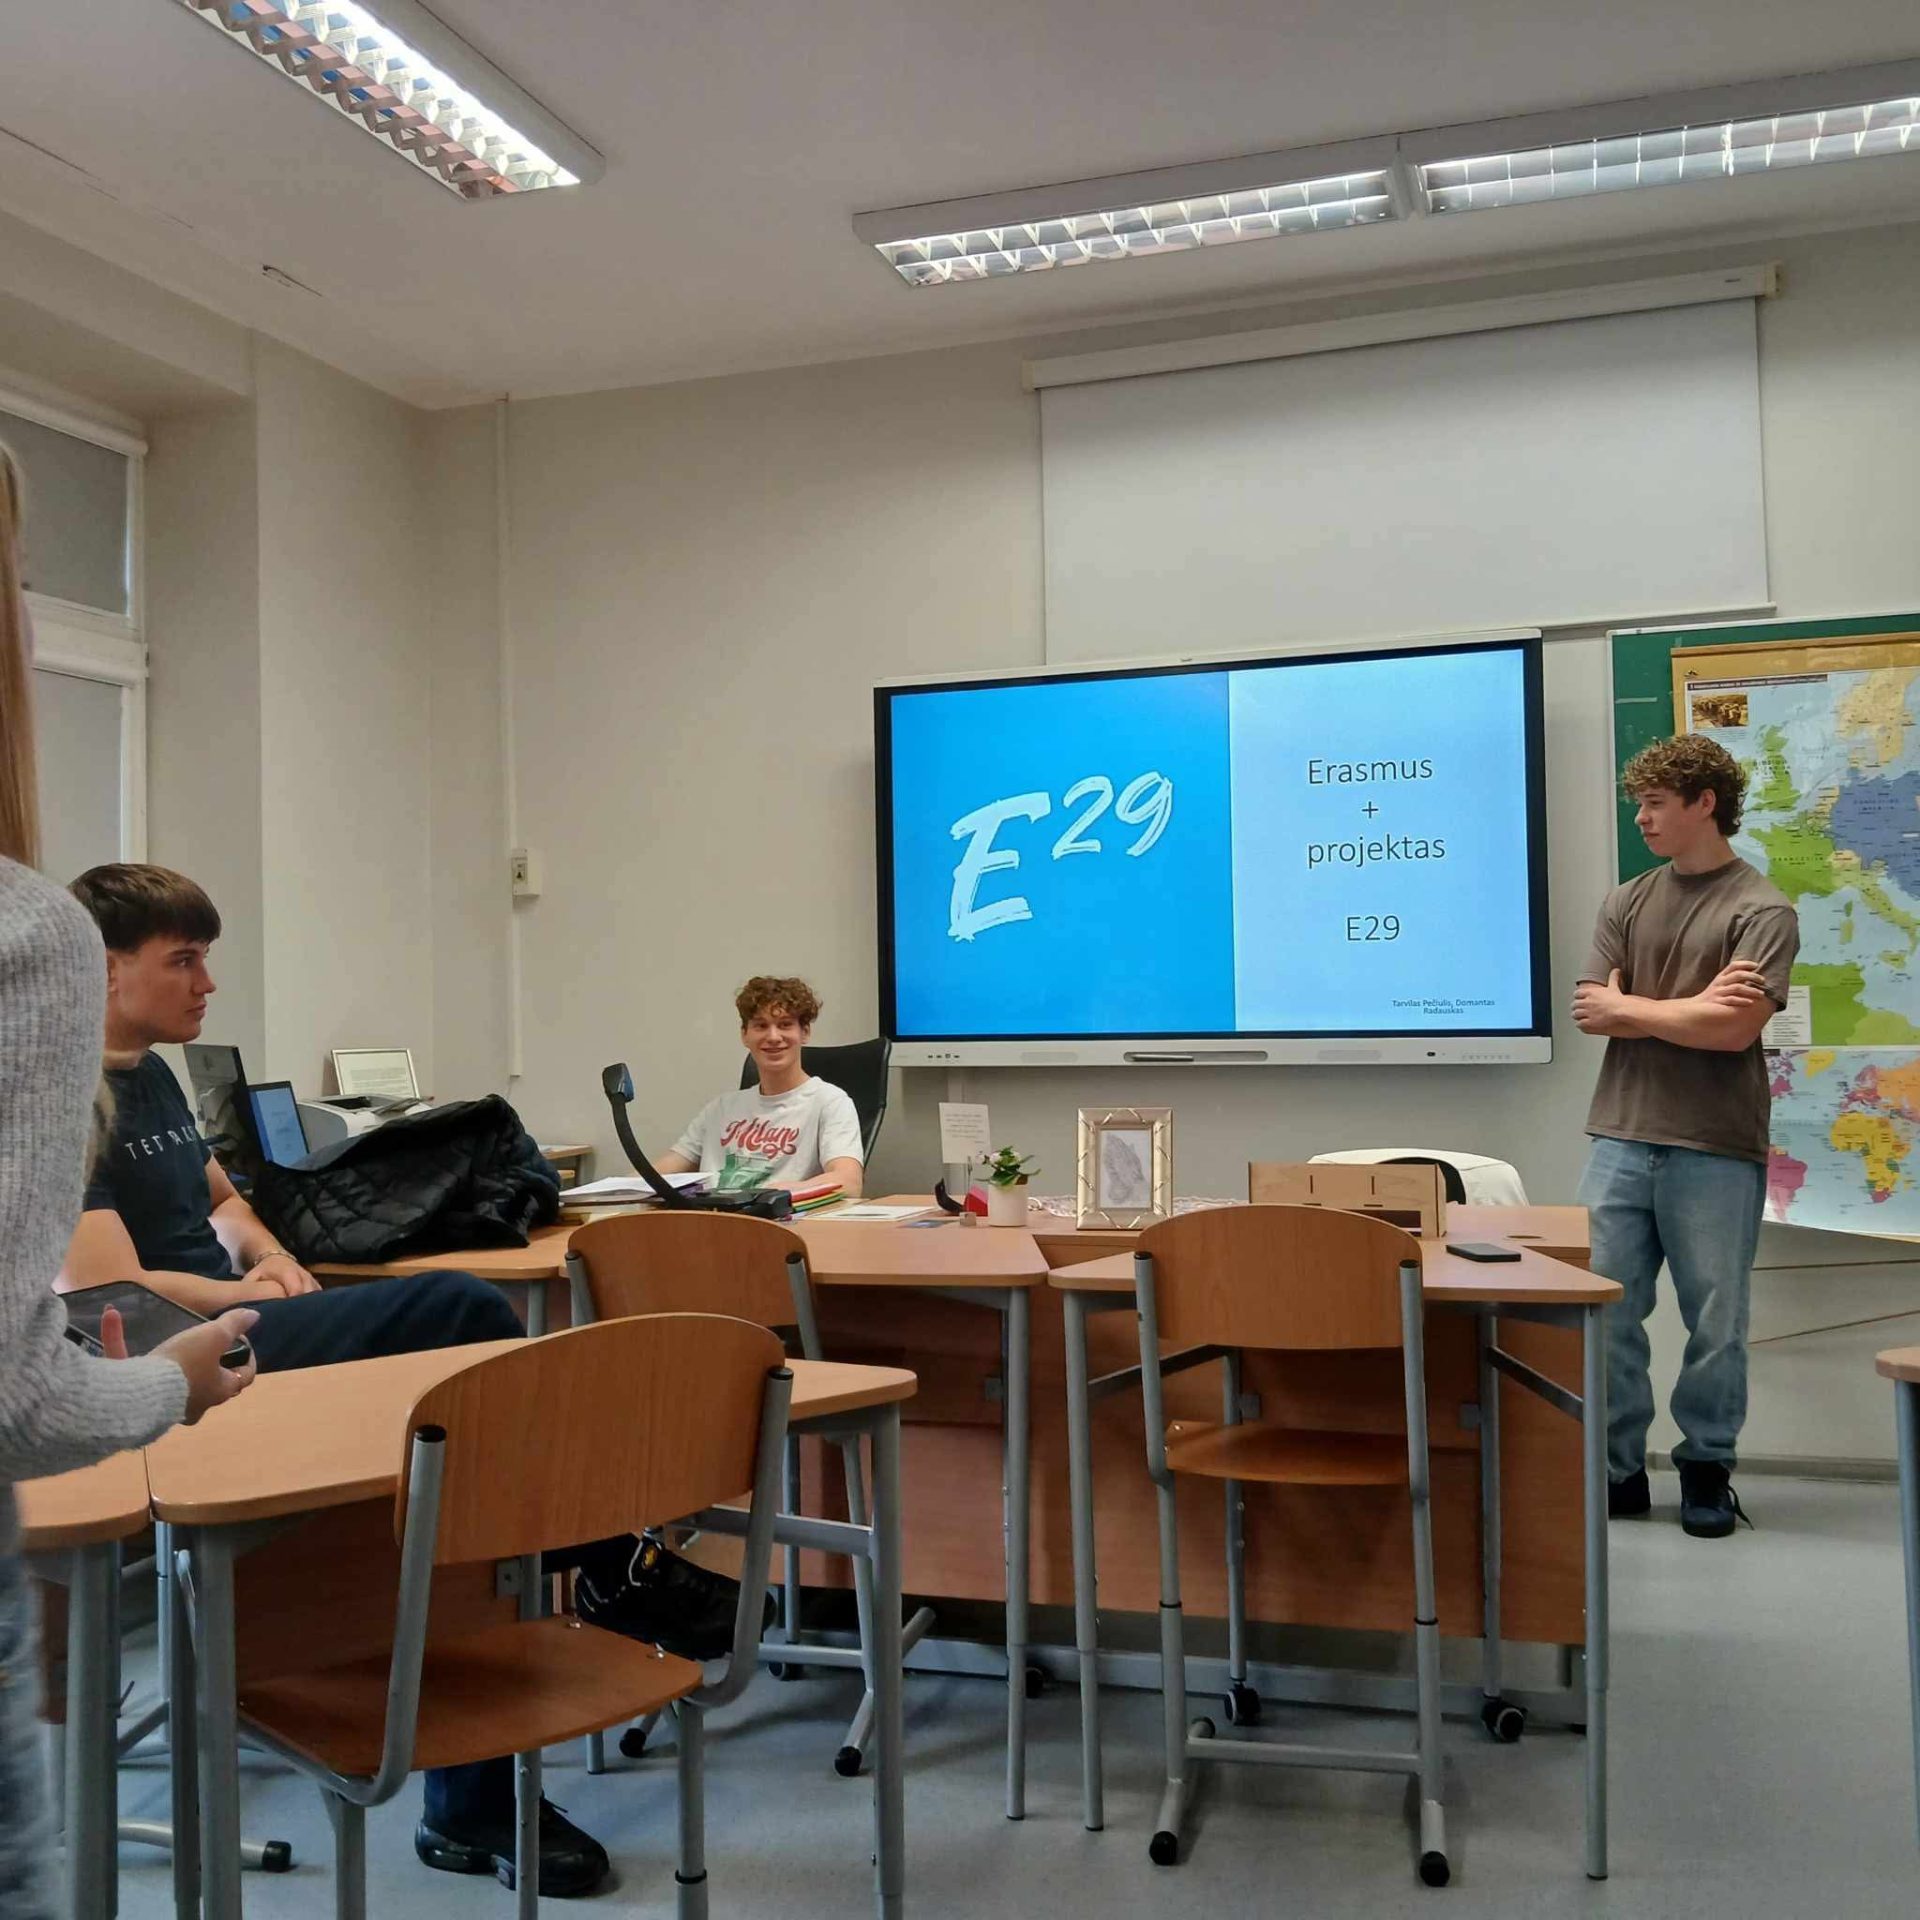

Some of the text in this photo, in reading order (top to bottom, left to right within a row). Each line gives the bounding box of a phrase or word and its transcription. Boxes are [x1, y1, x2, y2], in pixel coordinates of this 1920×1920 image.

[1308, 757, 1434, 785] Erasmus
[1361, 801, 1380, 820] +
[948, 771, 1173, 942] E29
[1308, 834, 1446, 870] projektas
[1346, 914, 1400, 942] E29
[1392, 999, 1421, 1008] Tarvilas
[1455, 998, 1495, 1007] Domantas
[1423, 1006, 1464, 1015] Radauskas
[720, 1117, 800, 1159] Milano
